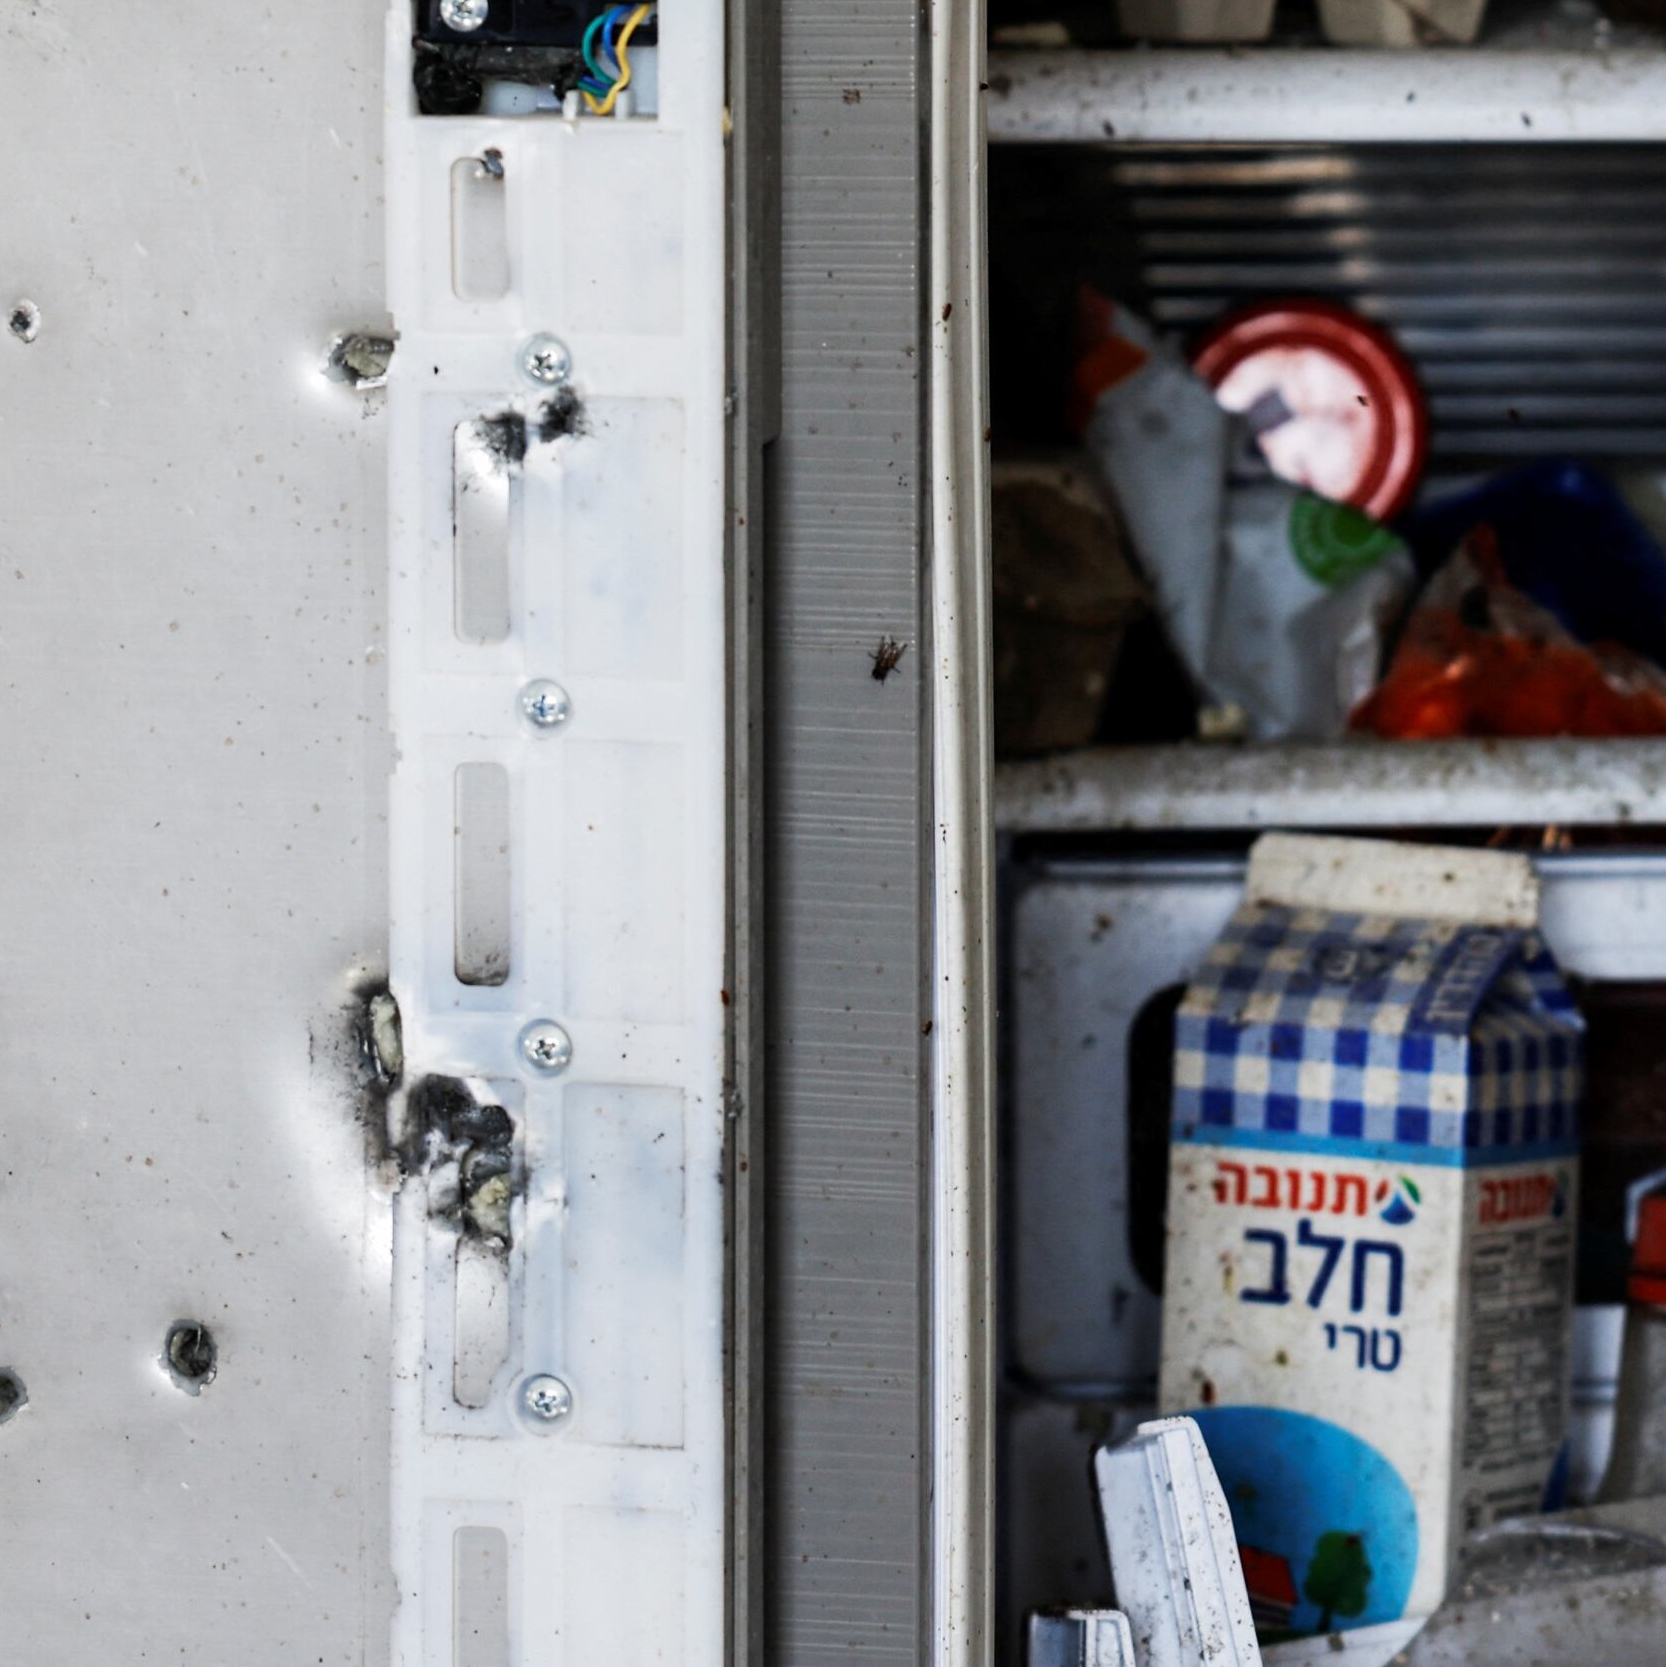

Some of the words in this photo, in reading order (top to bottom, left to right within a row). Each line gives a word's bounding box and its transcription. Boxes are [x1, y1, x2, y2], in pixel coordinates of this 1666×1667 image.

[1213, 1160, 1369, 1216] תנובה
[1240, 1218, 1404, 1317] חלב
[1323, 1322, 1403, 1373] טרי
